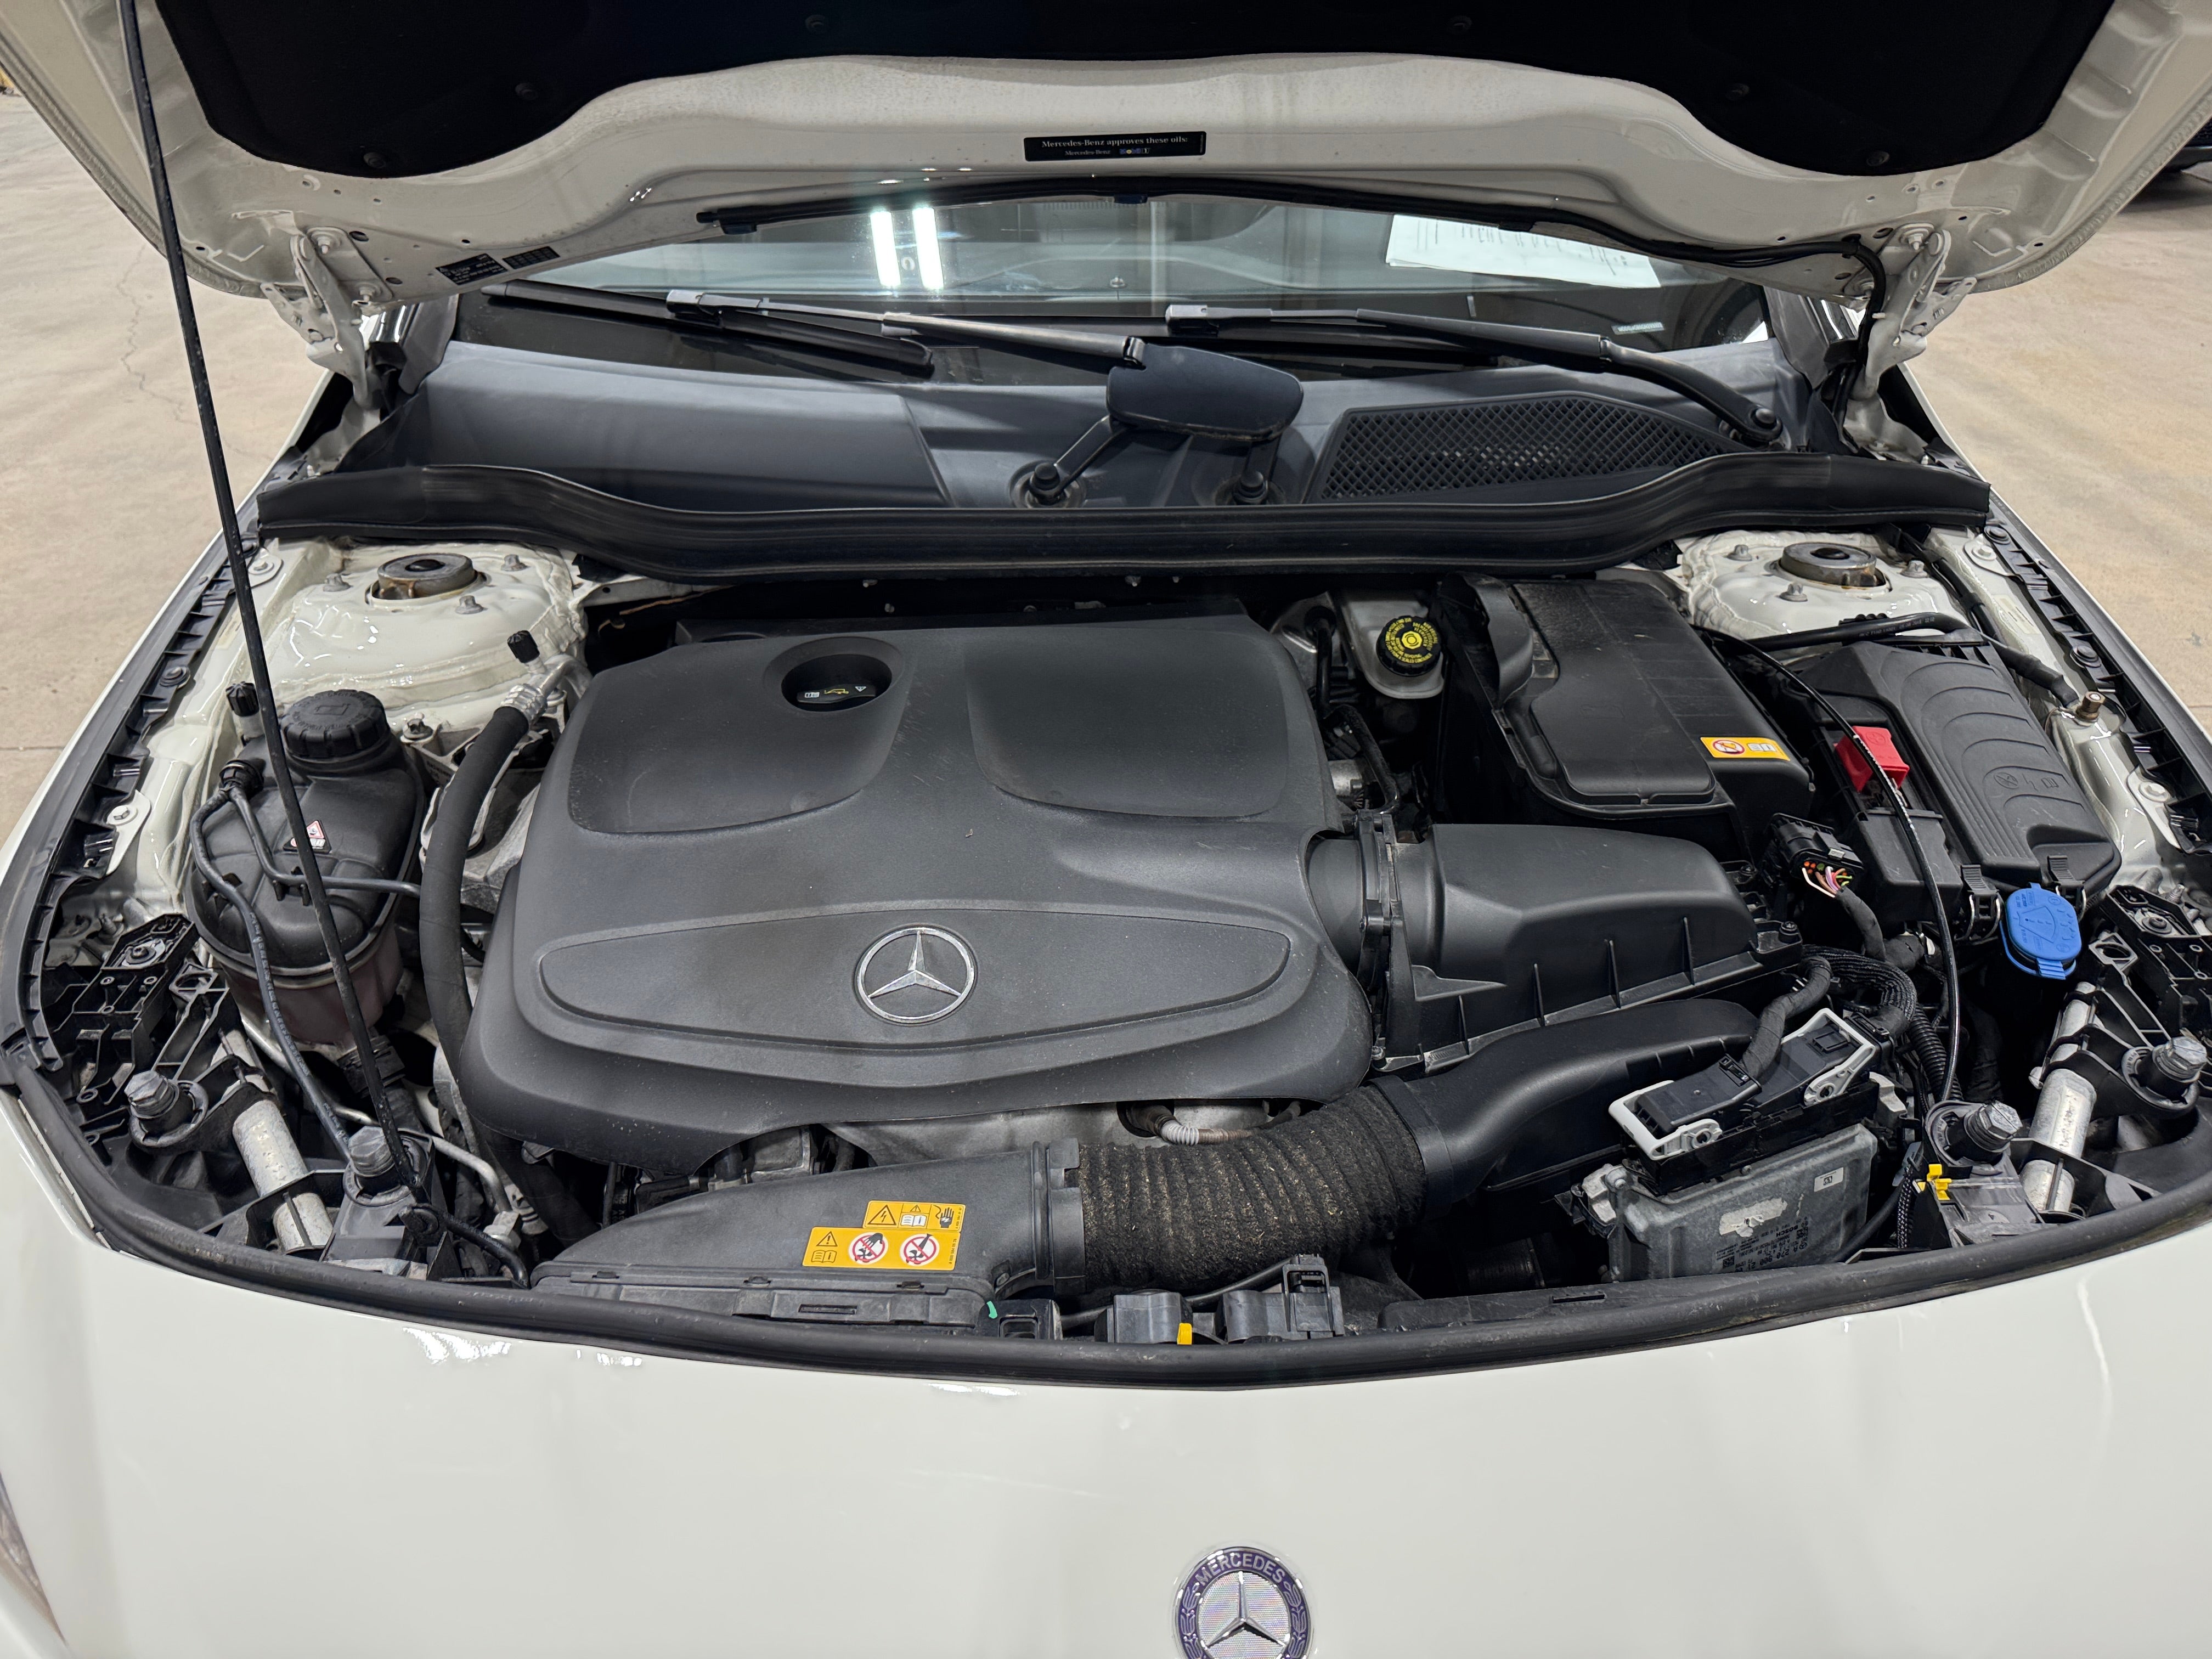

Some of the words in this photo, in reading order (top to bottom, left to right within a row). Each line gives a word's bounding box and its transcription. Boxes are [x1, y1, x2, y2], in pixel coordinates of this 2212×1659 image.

[1042, 139, 1105, 148] Mercedes-Benz
[1106, 137, 1144, 146] approves
[1776, 1224, 1798, 1237] BOSCH
[1195, 1553, 1286, 1586] MERCEDES
